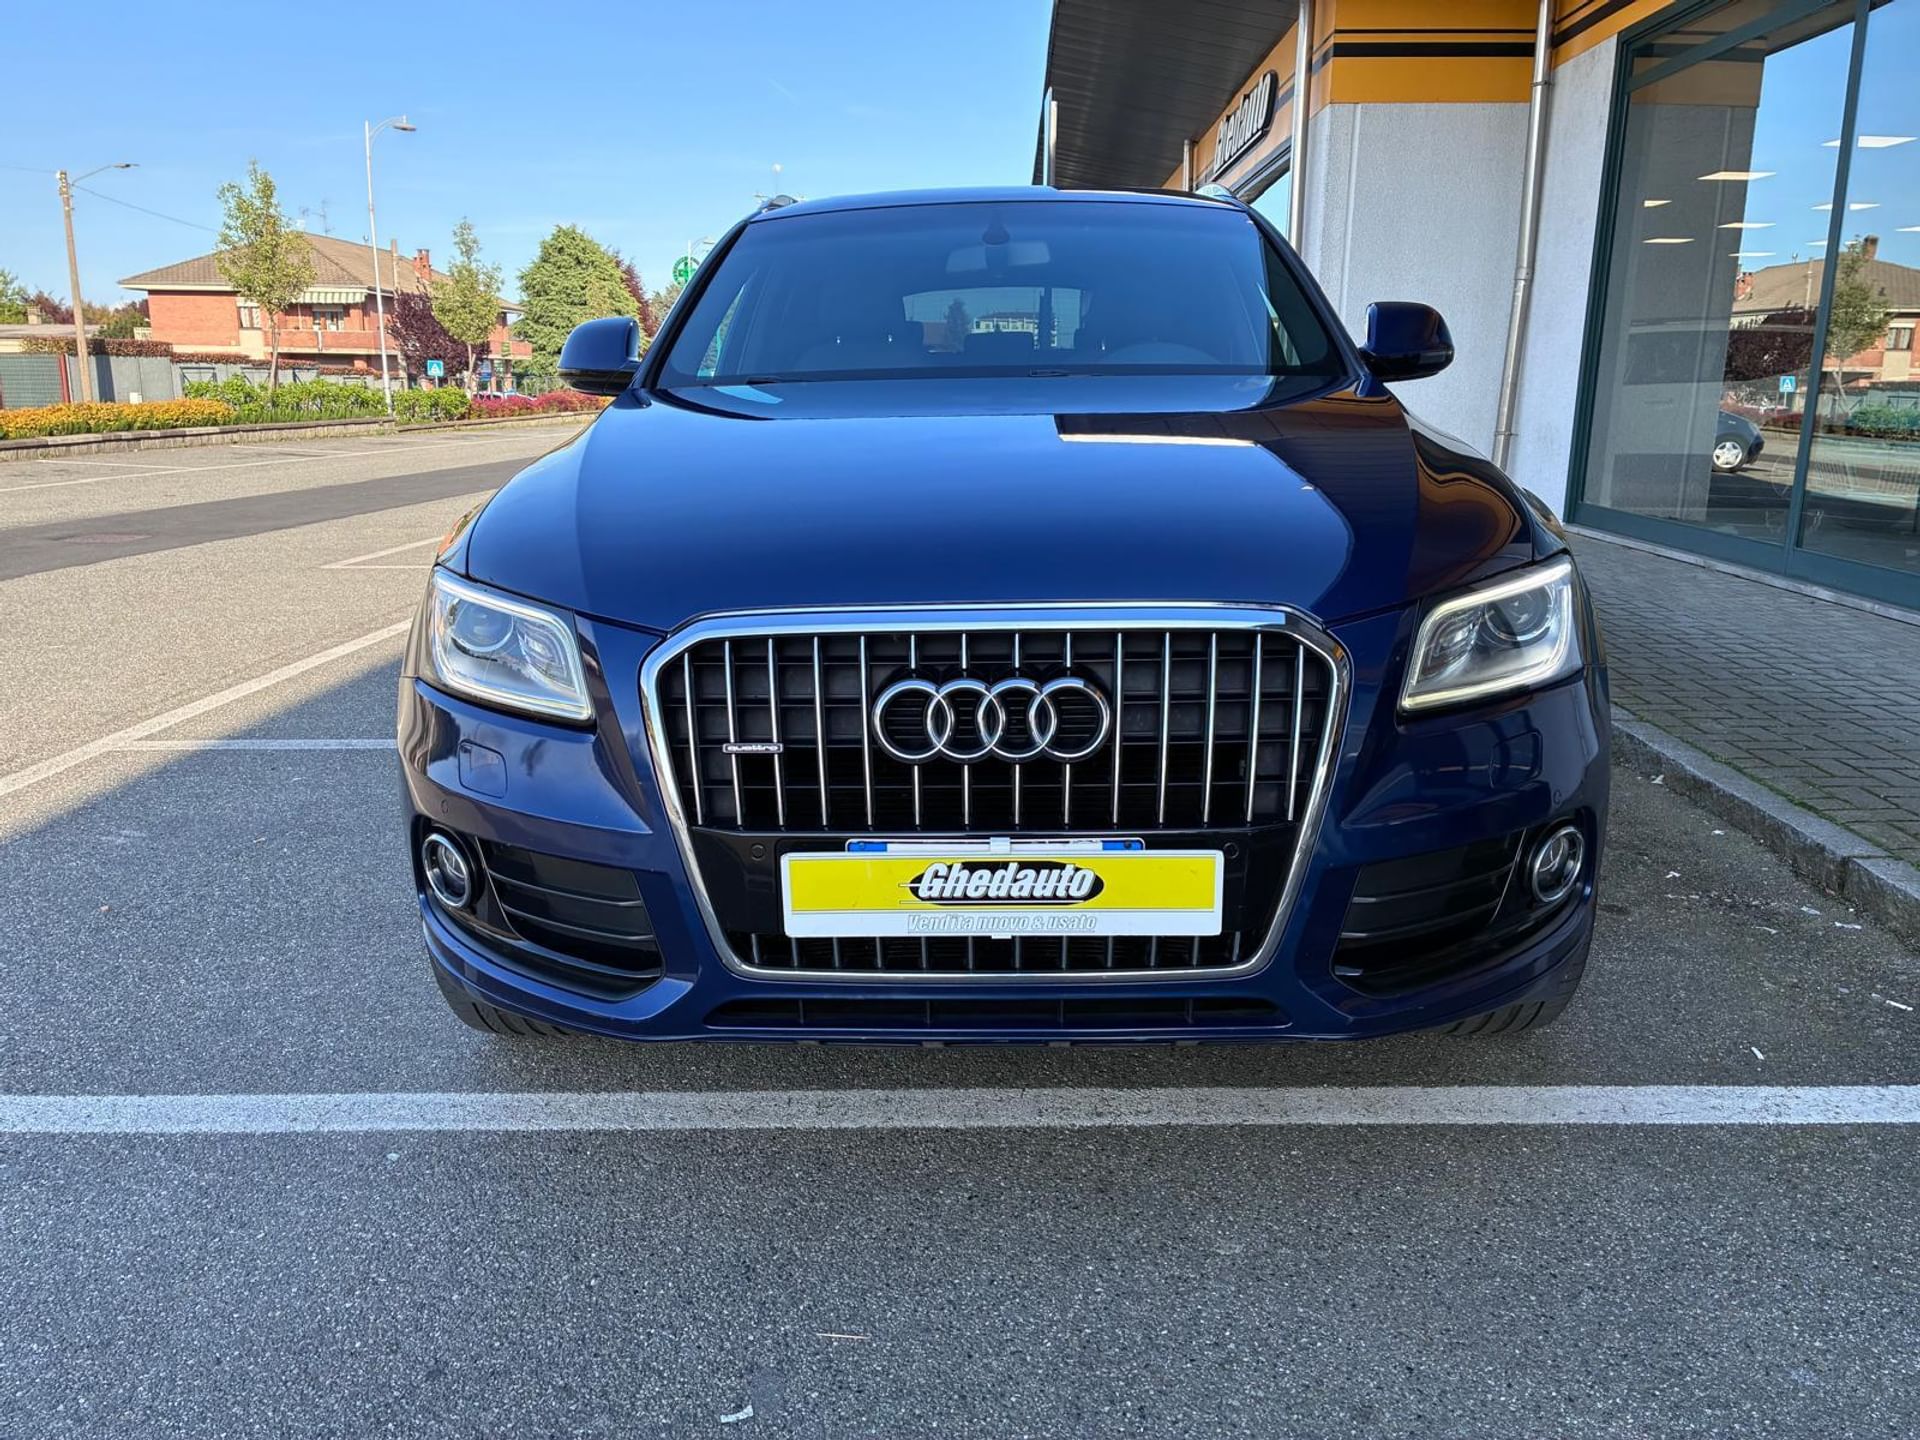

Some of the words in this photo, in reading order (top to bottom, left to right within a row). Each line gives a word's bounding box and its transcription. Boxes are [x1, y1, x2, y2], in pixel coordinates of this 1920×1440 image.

[918, 861, 1096, 899] Ghedauto
[908, 914, 974, 932] Vendita
[977, 917, 1029, 932] nuovo
[1031, 916, 1046, 931] &
[1048, 914, 1097, 932] usato
